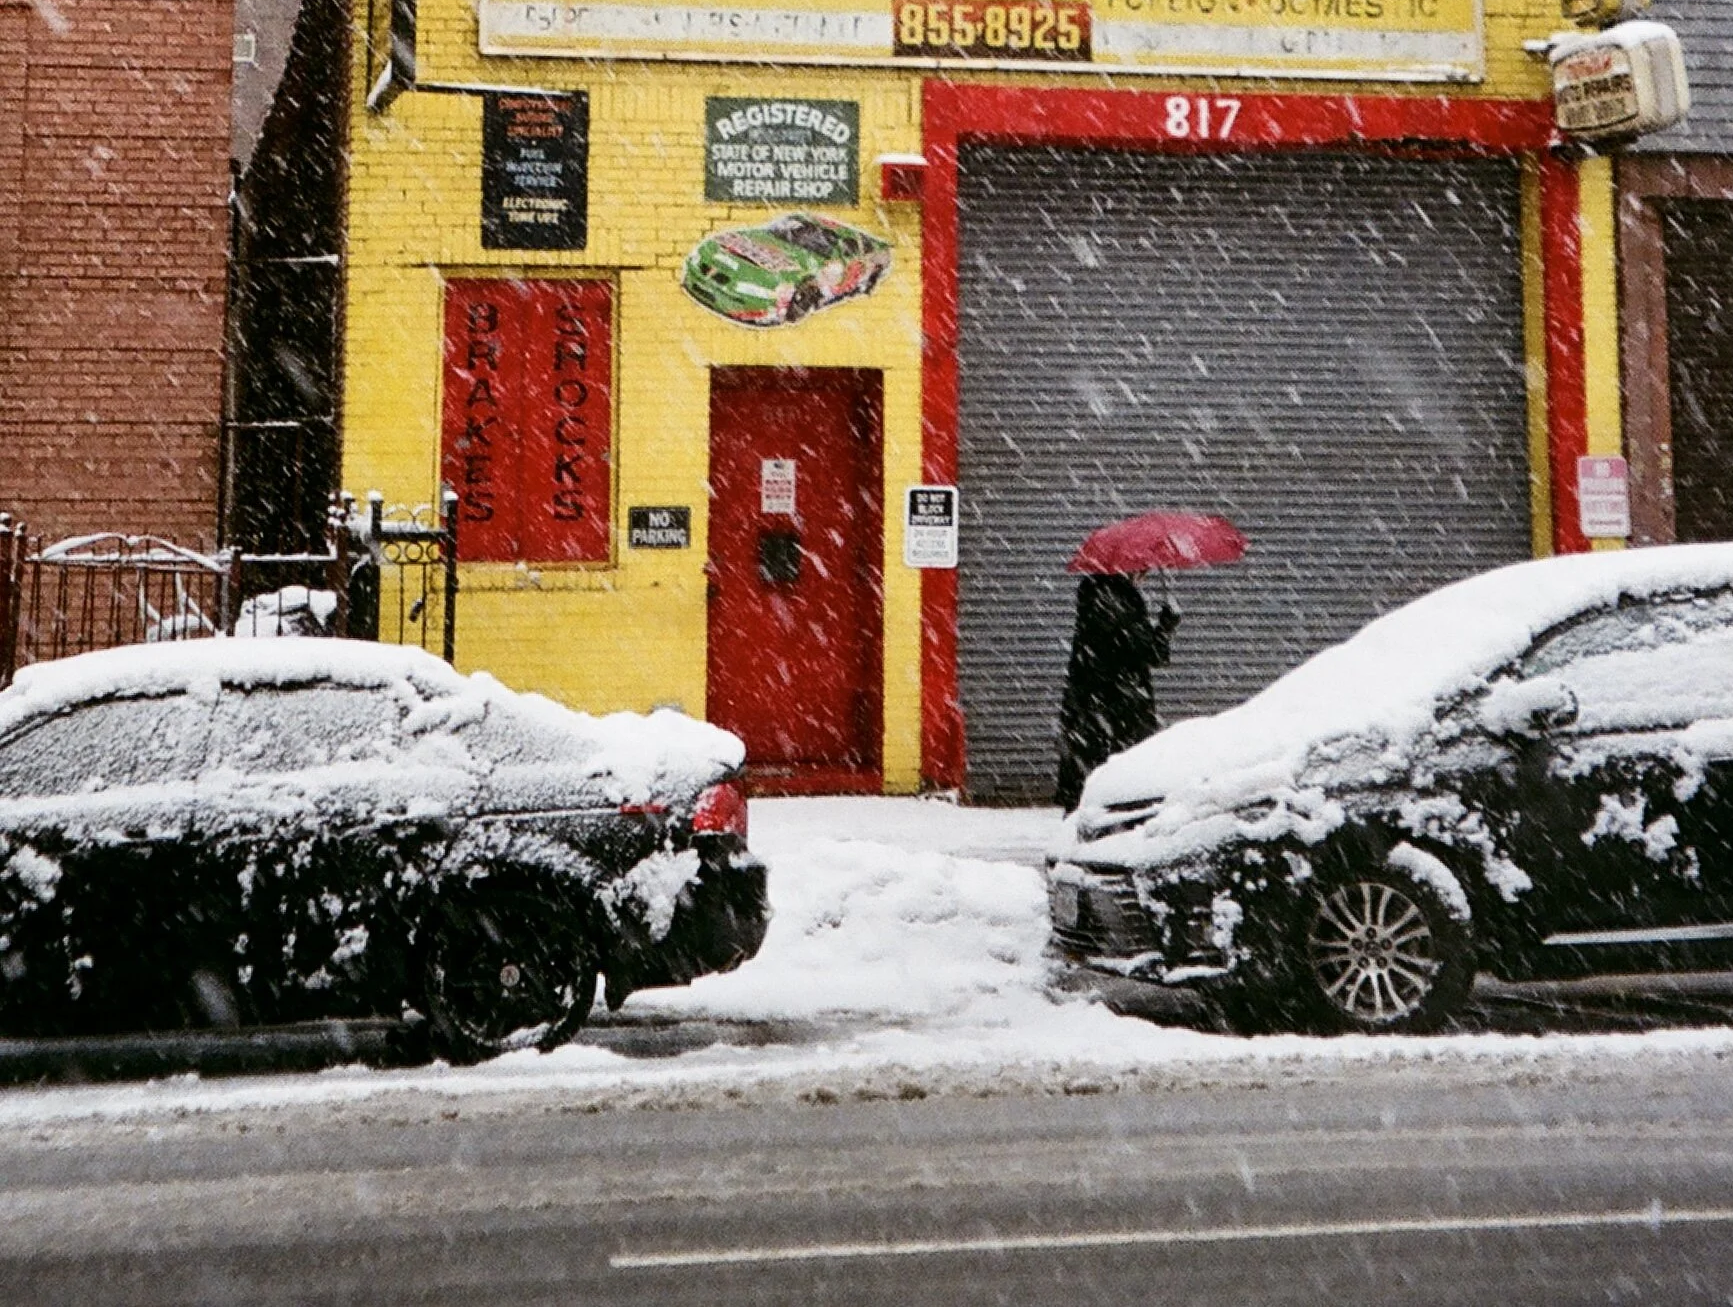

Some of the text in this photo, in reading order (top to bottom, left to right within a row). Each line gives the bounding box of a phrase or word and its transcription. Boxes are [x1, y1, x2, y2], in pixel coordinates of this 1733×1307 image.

[899, 4, 1081, 52] 855-8925
[715, 103, 851, 144] REGISTERED
[1164, 95, 1242, 139] 817
[711, 144, 849, 162] STATE OF NEW YORK
[717, 161, 849, 180] MOTOR VEHICLE
[732, 179, 834, 198] REPAIR SHOP
[463, 301, 499, 523] BRAKES
[553, 303, 589, 522] SHOCKS
[648, 512, 671, 528] NO
[631, 528, 688, 546] PARKING
